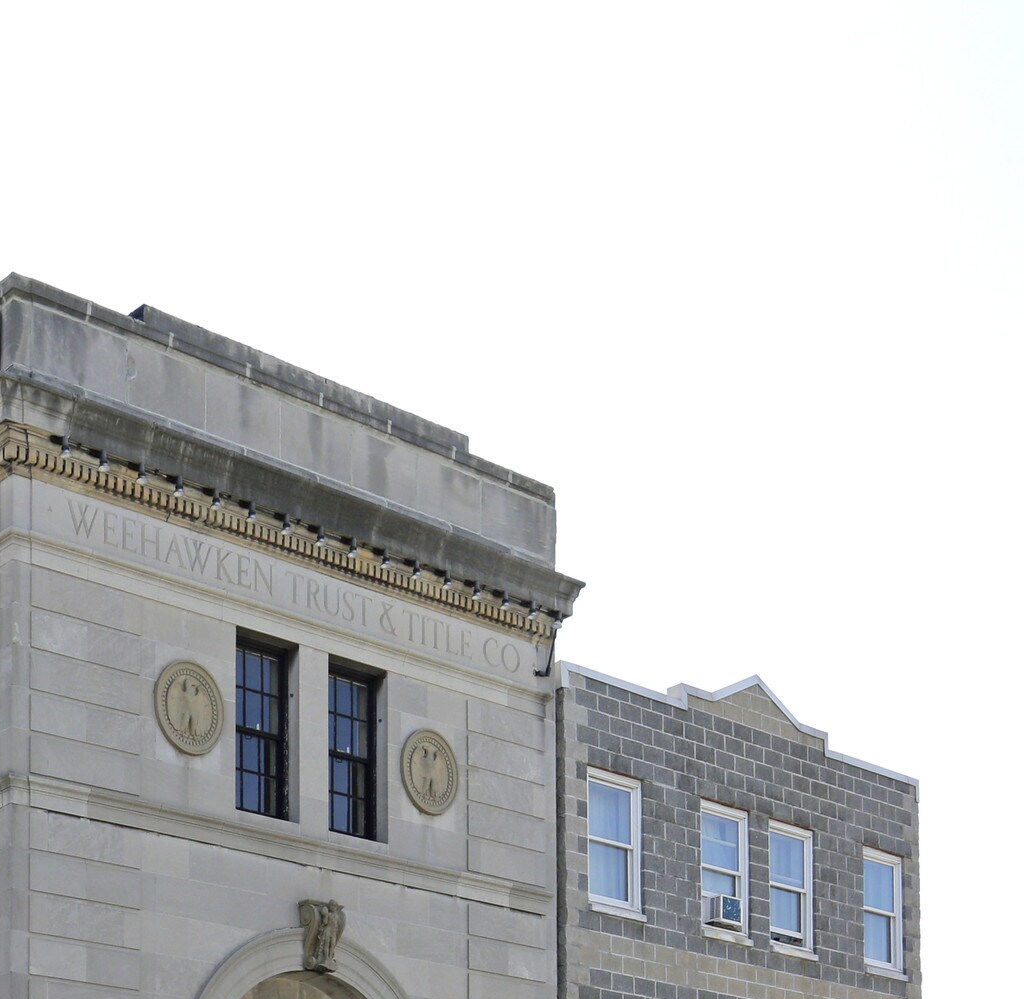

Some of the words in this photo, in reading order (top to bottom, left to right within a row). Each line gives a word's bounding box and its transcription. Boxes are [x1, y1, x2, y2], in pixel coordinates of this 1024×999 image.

[68, 500, 274, 598] WEEHAWKEN
[285, 571, 373, 627] TRUST
[380, 602, 397, 637] &
[402, 609, 473, 660] TITLE
[482, 636, 521, 674] CO
